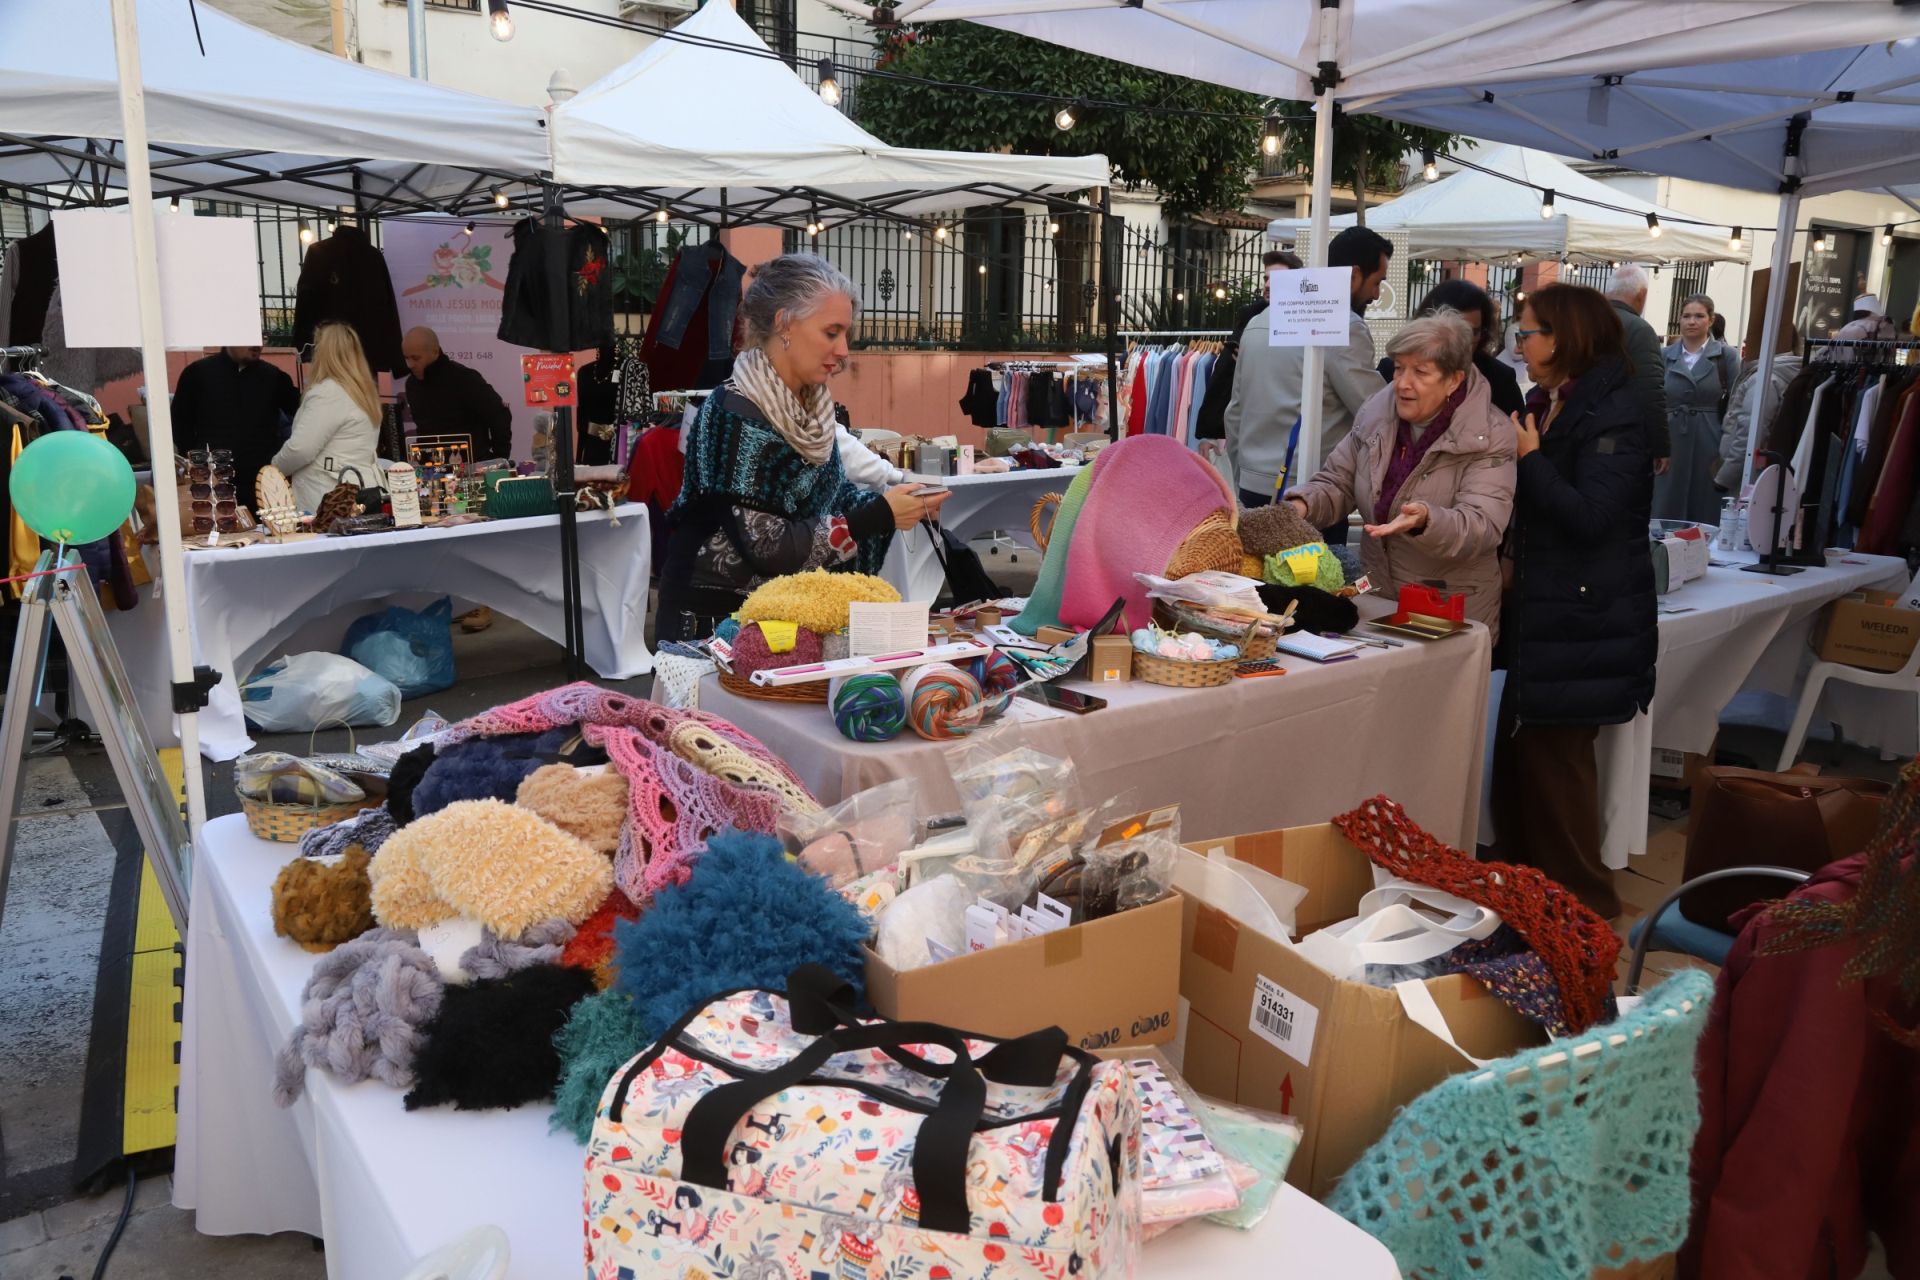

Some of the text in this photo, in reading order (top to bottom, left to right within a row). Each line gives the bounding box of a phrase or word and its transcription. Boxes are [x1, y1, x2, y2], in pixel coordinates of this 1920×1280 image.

[408, 299, 502, 310] MARIA JESUS MOD
[457, 351, 473, 360] 921
[476, 351, 494, 360] 648
[1860, 620, 1909, 635] WELEDA
[1260, 994, 1294, 1023] 914331
